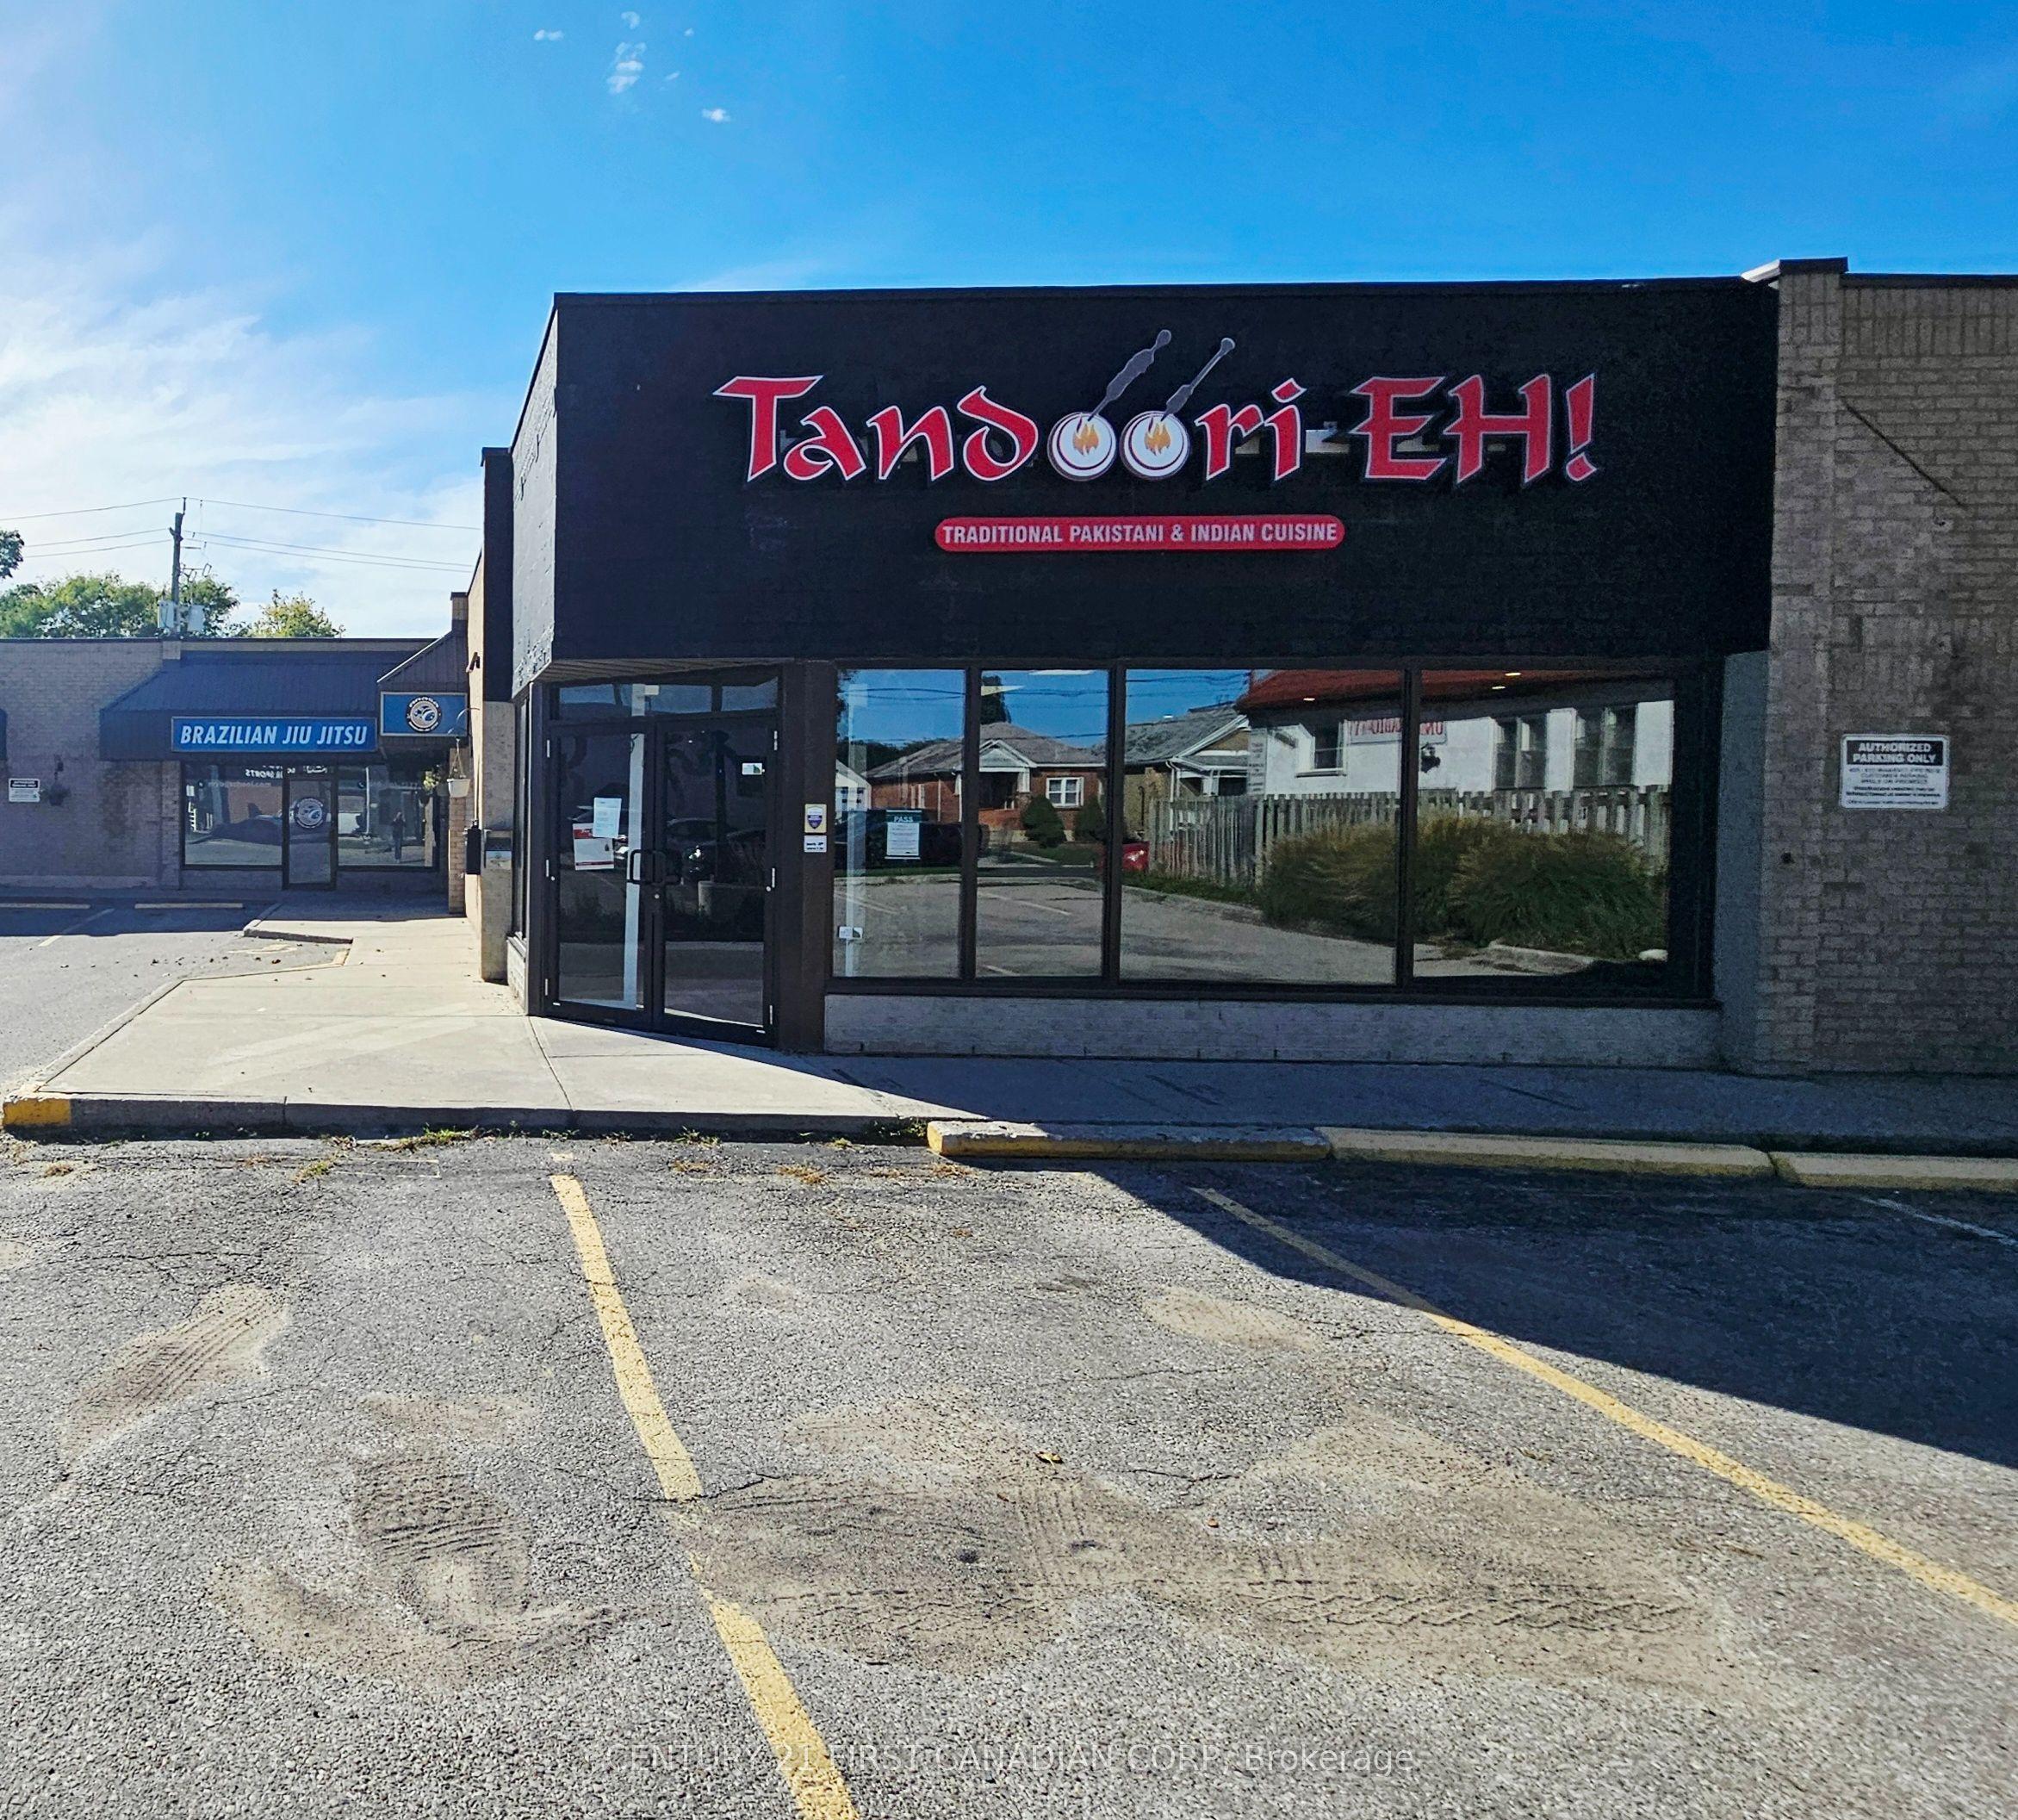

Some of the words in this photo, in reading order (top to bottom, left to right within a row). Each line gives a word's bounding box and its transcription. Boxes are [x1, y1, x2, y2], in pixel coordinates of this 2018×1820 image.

[712, 373, 1307, 482] Tandoori
[1349, 373, 1598, 484] EH!
[943, 525, 1063, 544] TRADITIONAL
[1070, 524, 1164, 544] PAKISTANI
[1170, 525, 1183, 542] &
[1191, 524, 1255, 543] INDIAN
[1261, 523, 1337, 542] CUISINE
[180, 725, 277, 744] BRAZILIAN
[282, 725, 312, 744] JIU
[316, 725, 368, 744] JITSU
[1858, 742, 1931, 752] AUTHORIZED
[1853, 753, 1904, 762] PARKING
[1907, 753, 1936, 763] ONLY
